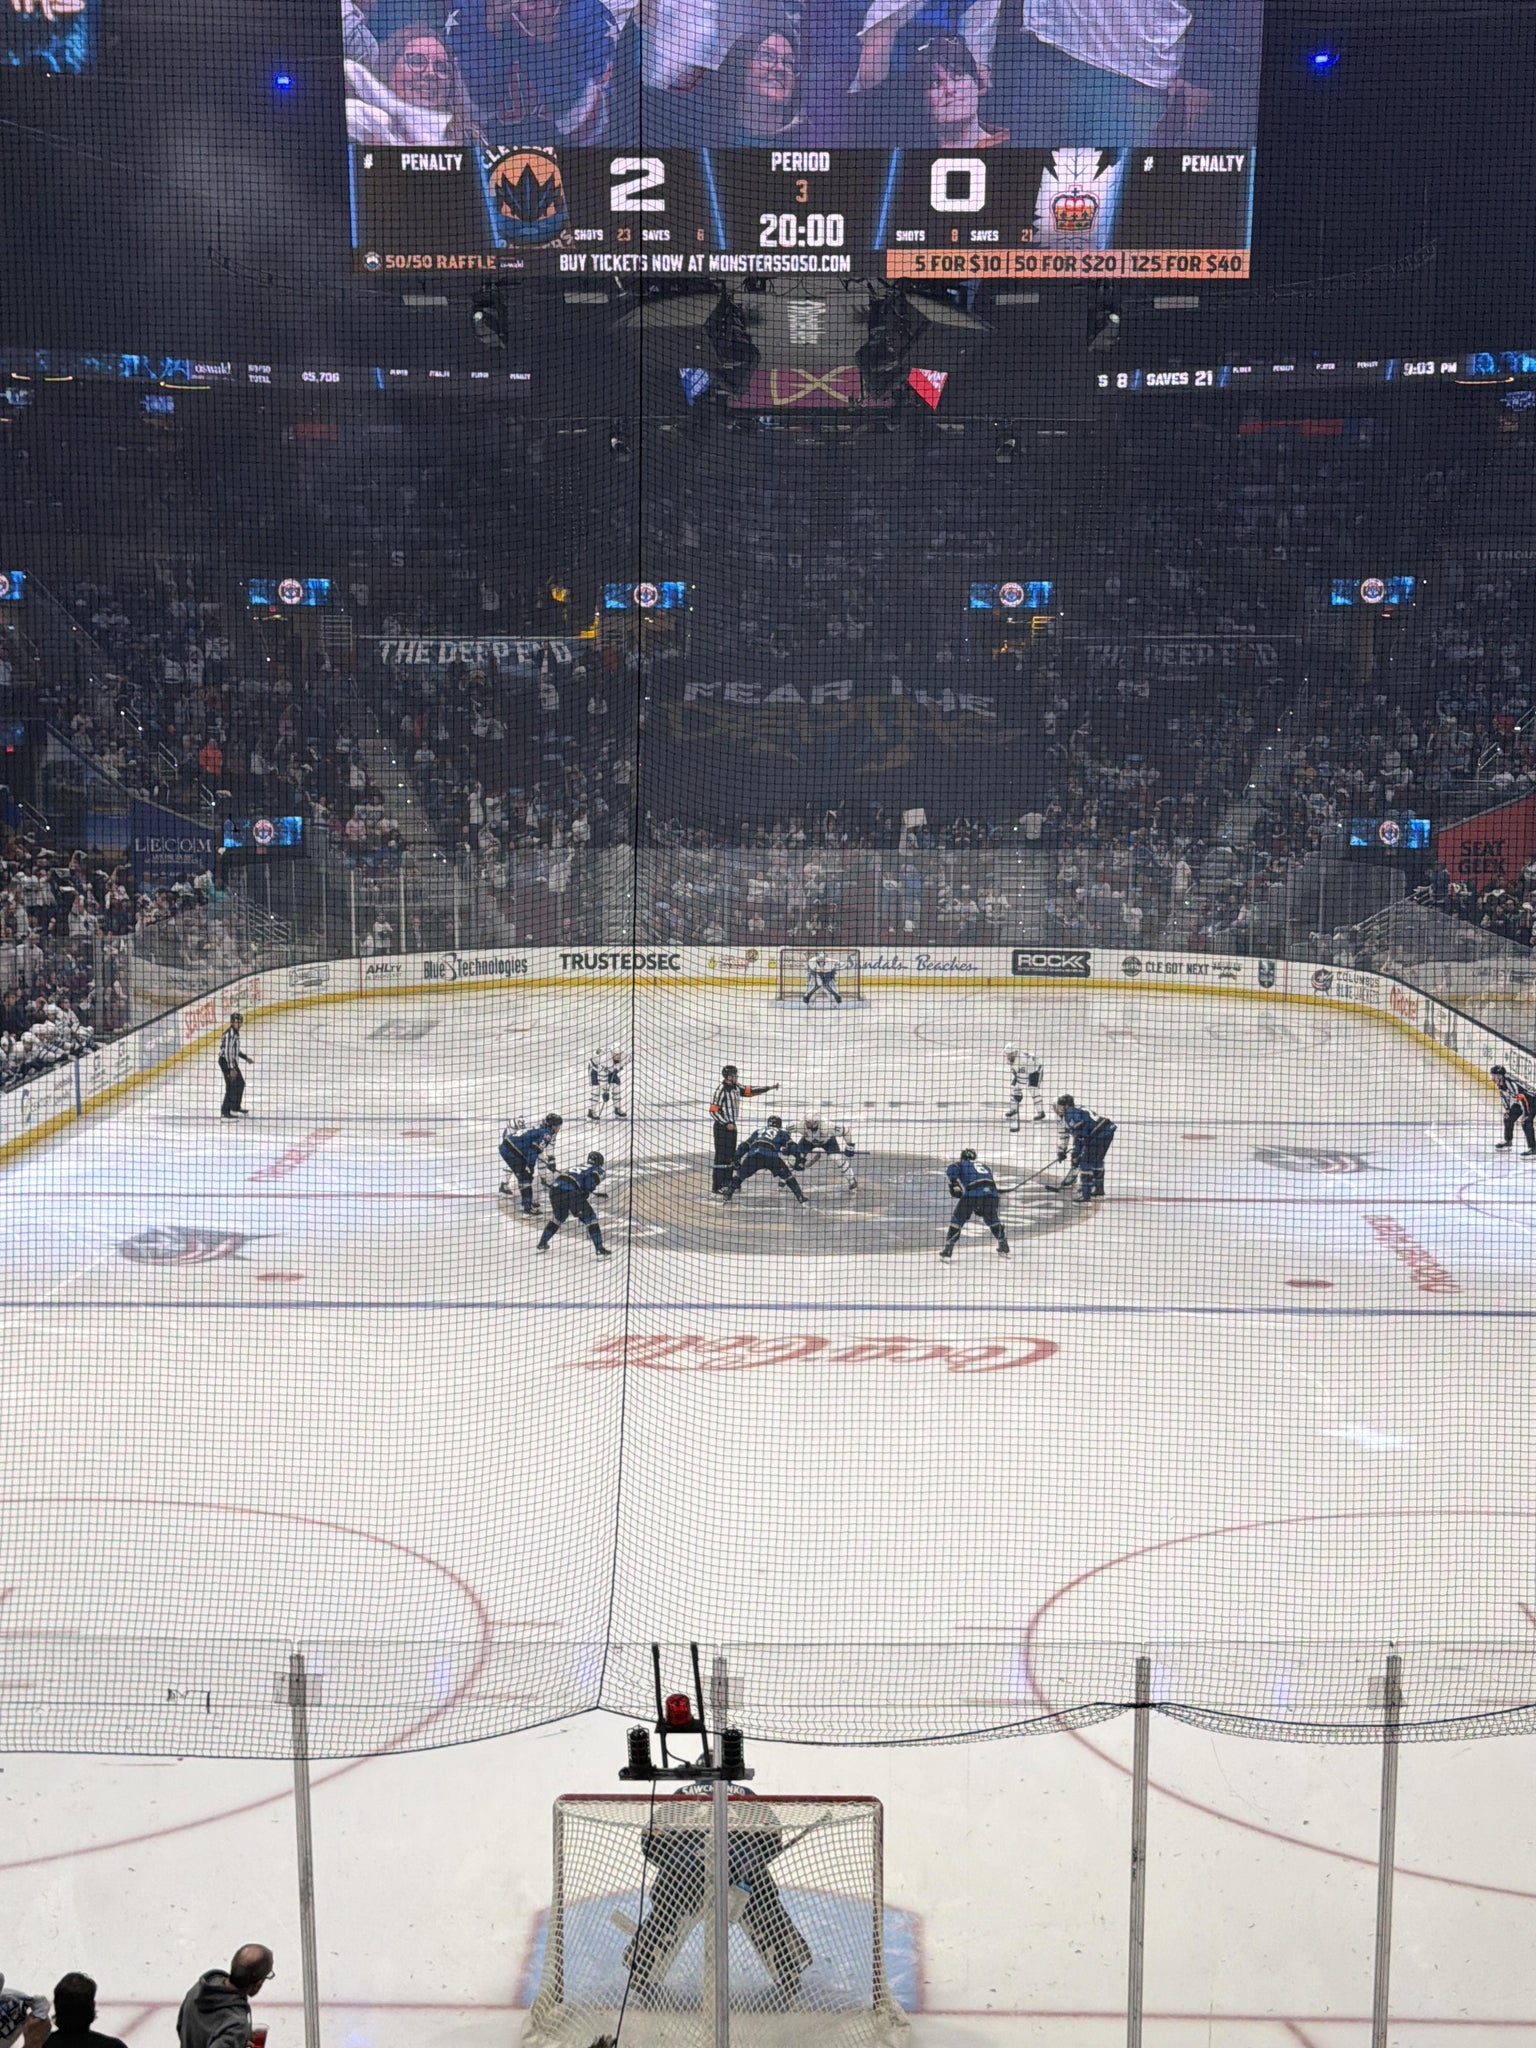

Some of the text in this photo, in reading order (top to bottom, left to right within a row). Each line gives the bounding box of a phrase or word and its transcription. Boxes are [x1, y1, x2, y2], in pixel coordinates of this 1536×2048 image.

[401, 153, 463, 171] PENALTY
[771, 152, 830, 171] PERIOD
[1182, 155, 1244, 172] PENALTY
[610, 157, 665, 211] 2
[795, 179, 808, 203] 3
[931, 158, 986, 212] 0
[574, 229, 604, 241] SHOTS
[617, 228, 631, 242] 23
[642, 229, 670, 241] SAVES
[760, 213, 844, 247] 20:00
[896, 230, 925, 242] SHOTS
[970, 230, 999, 242] SAVES
[1020, 230, 1033, 242] 21
[385, 254, 496, 270] 50/50 RAFFLE
[560, 254, 851, 272] BUY TICKETS NOW AT MONSTERS5050.COM
[915, 254, 1242, 274] 5 FOR $10 50 FOR $20 125 FOR $40
[1441, 361, 1457, 374] PM
[1117, 373, 1128, 388] 8
[1146, 370, 1213, 386] SAVES 21
[380, 640, 430, 664] THE
[1460, 841, 1506, 856] SEAT
[424, 955, 528, 979] Blue Technologies
[559, 953, 681, 970] TRUSTEDSEC
[915, 954, 979, 971] Beaches
[1145, 961, 1162, 974] CLE
[1165, 962, 1183, 974] GOT
[1186, 963, 1210, 975] NEXT
